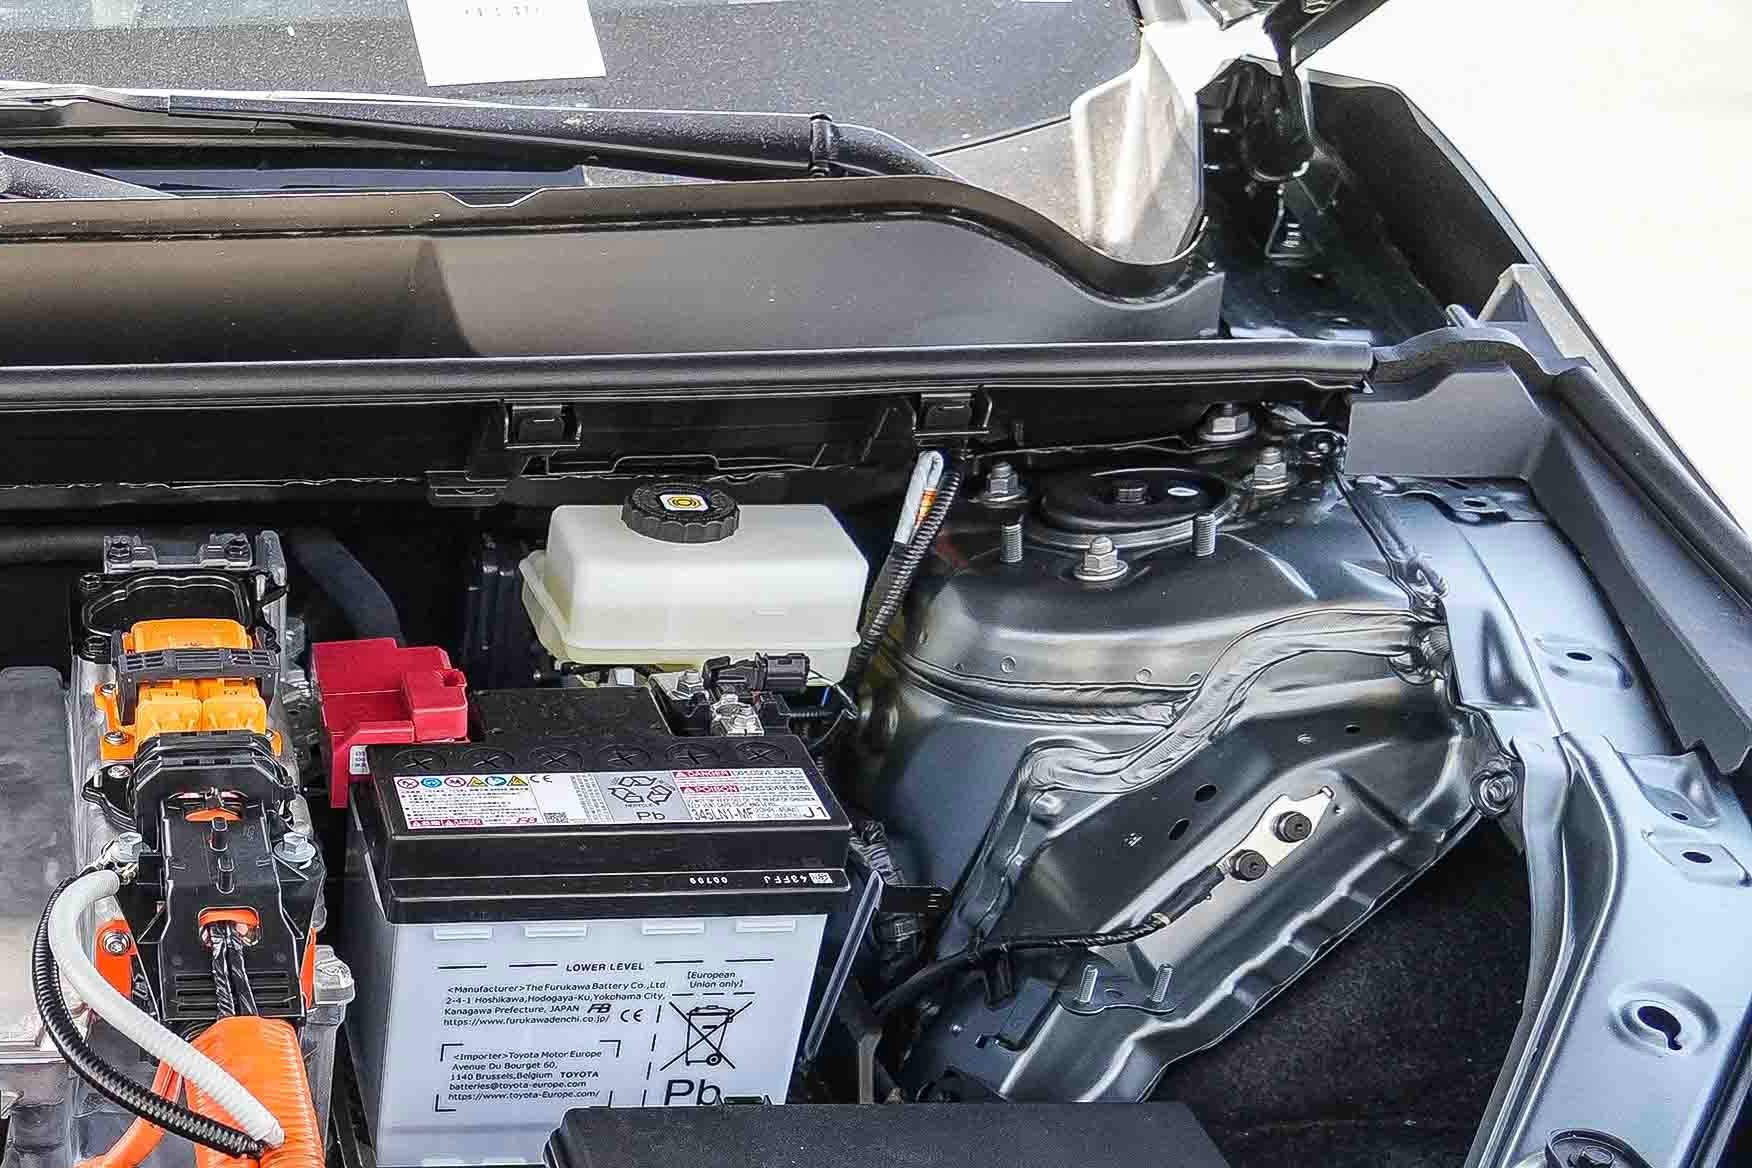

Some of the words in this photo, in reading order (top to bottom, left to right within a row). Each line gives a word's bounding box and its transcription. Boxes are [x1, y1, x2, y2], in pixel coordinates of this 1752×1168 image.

[636, 811, 666, 821] Pb
[566, 963, 606, 972] LOWER
[609, 962, 644, 971] LEVEL
[592, 982, 629, 991] Battery
[446, 995, 471, 1004] 2-4-1
[644, 992, 665, 1001] City,
[444, 1007, 492, 1016] Kanagawa
[494, 1005, 547, 1014] Prefecture,
[570, 1050, 602, 1058] Europe
[452, 1062, 486, 1070] Avenue
[488, 1062, 501, 1070] Du
[504, 1062, 540, 1070] Bourget
[543, 1061, 558, 1070] 60,
[449, 1081, 586, 1090] batteries@toyota-europe.com
[664, 1079, 721, 1105] Pb
